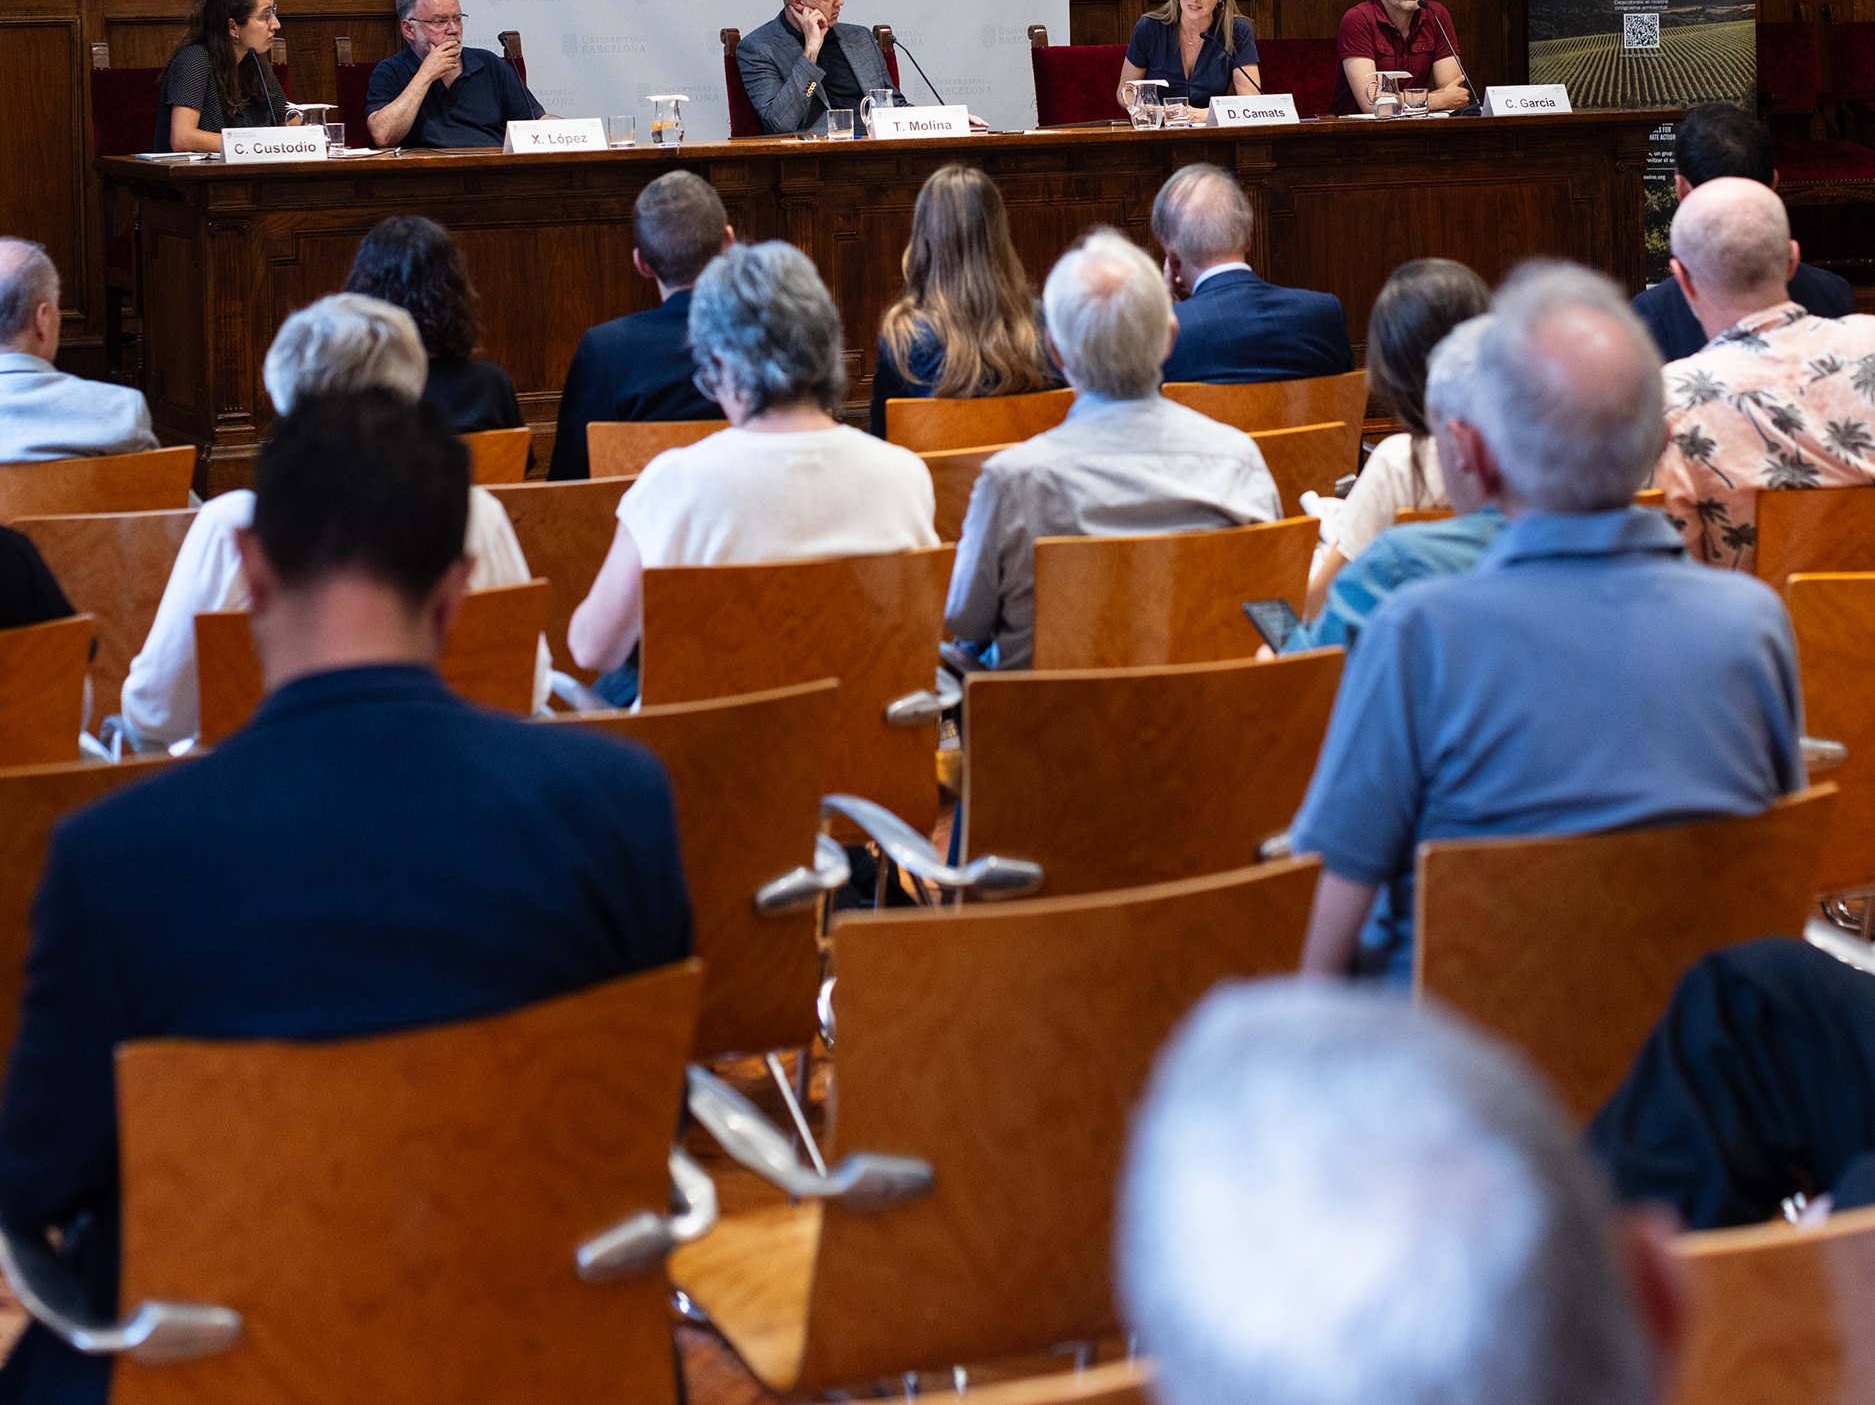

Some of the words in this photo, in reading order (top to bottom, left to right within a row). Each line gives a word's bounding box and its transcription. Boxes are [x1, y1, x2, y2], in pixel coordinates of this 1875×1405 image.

[582, 45, 646, 54] BARCELONA
[938, 86, 992, 95] ARCELONA
[1505, 99, 1518, 109] C.
[1519, 97, 1556, 109] García
[1227, 109, 1240, 119] D.
[1242, 108, 1286, 119] Camats
[892, 121, 905, 132] T.
[909, 120, 952, 132] Molina
[531, 134, 545, 145] X.
[548, 133, 588, 146] López
[234, 143, 249, 155] C.
[253, 141, 317, 154] Custodio
